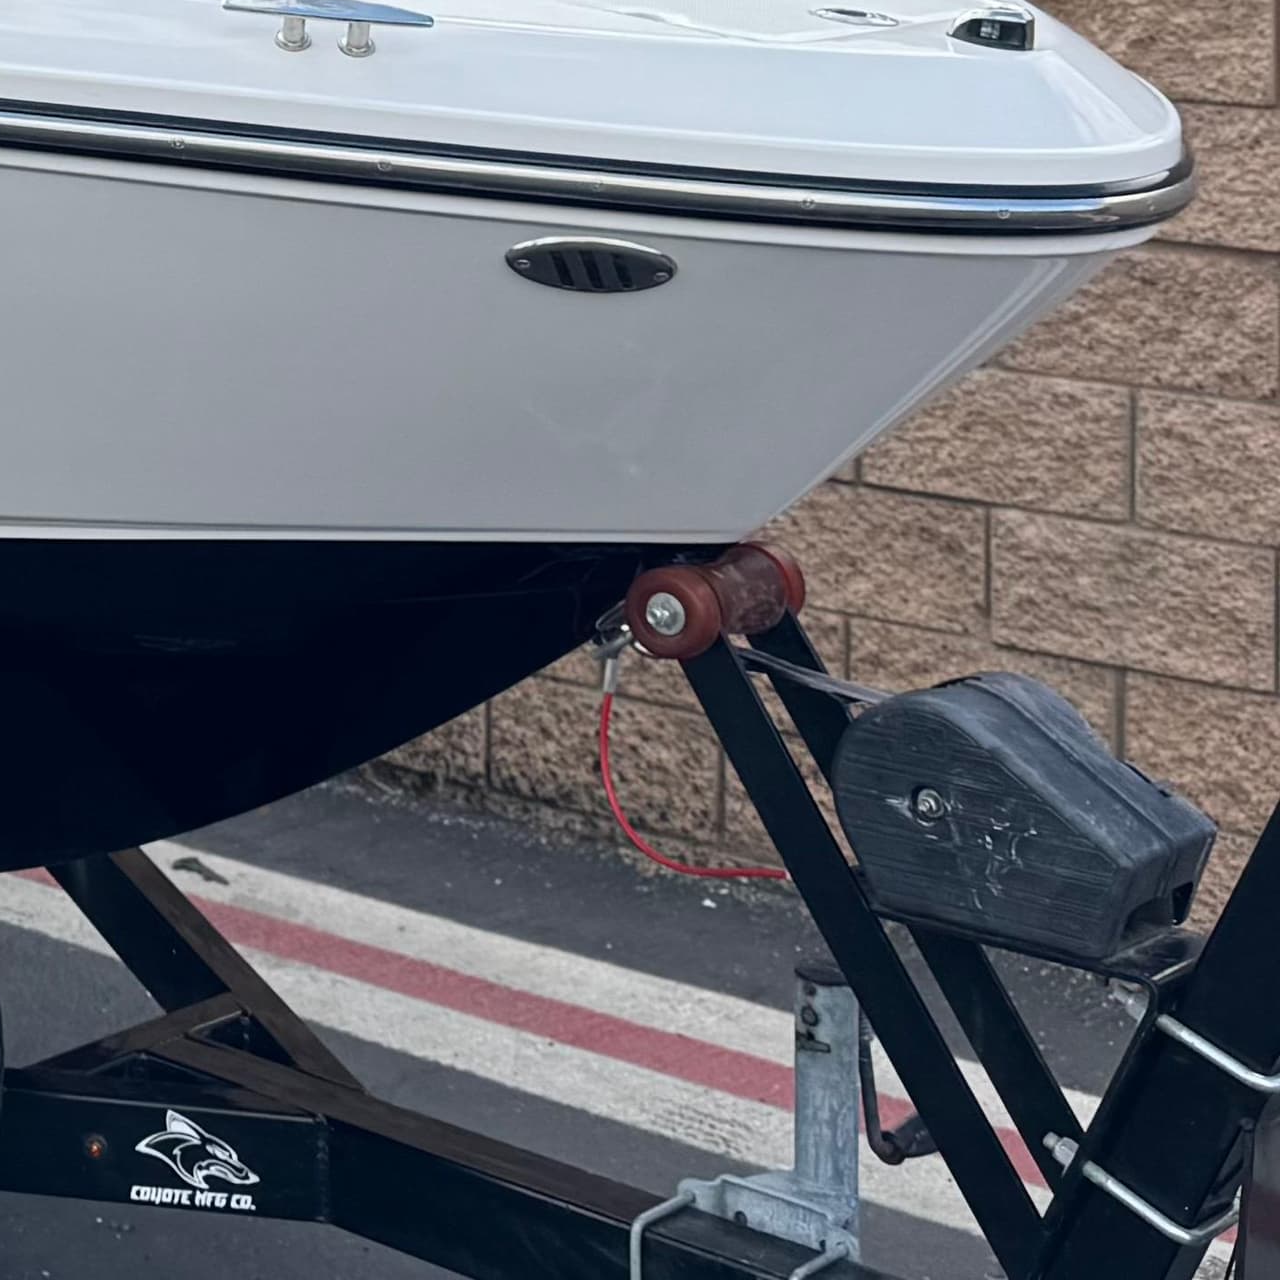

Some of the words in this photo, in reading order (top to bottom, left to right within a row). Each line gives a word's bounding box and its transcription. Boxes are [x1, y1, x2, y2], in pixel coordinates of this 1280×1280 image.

[130, 1185, 192, 1205] COYOTE
[194, 1190, 228, 1208] MFG
[230, 1194, 256, 1210] CO.
